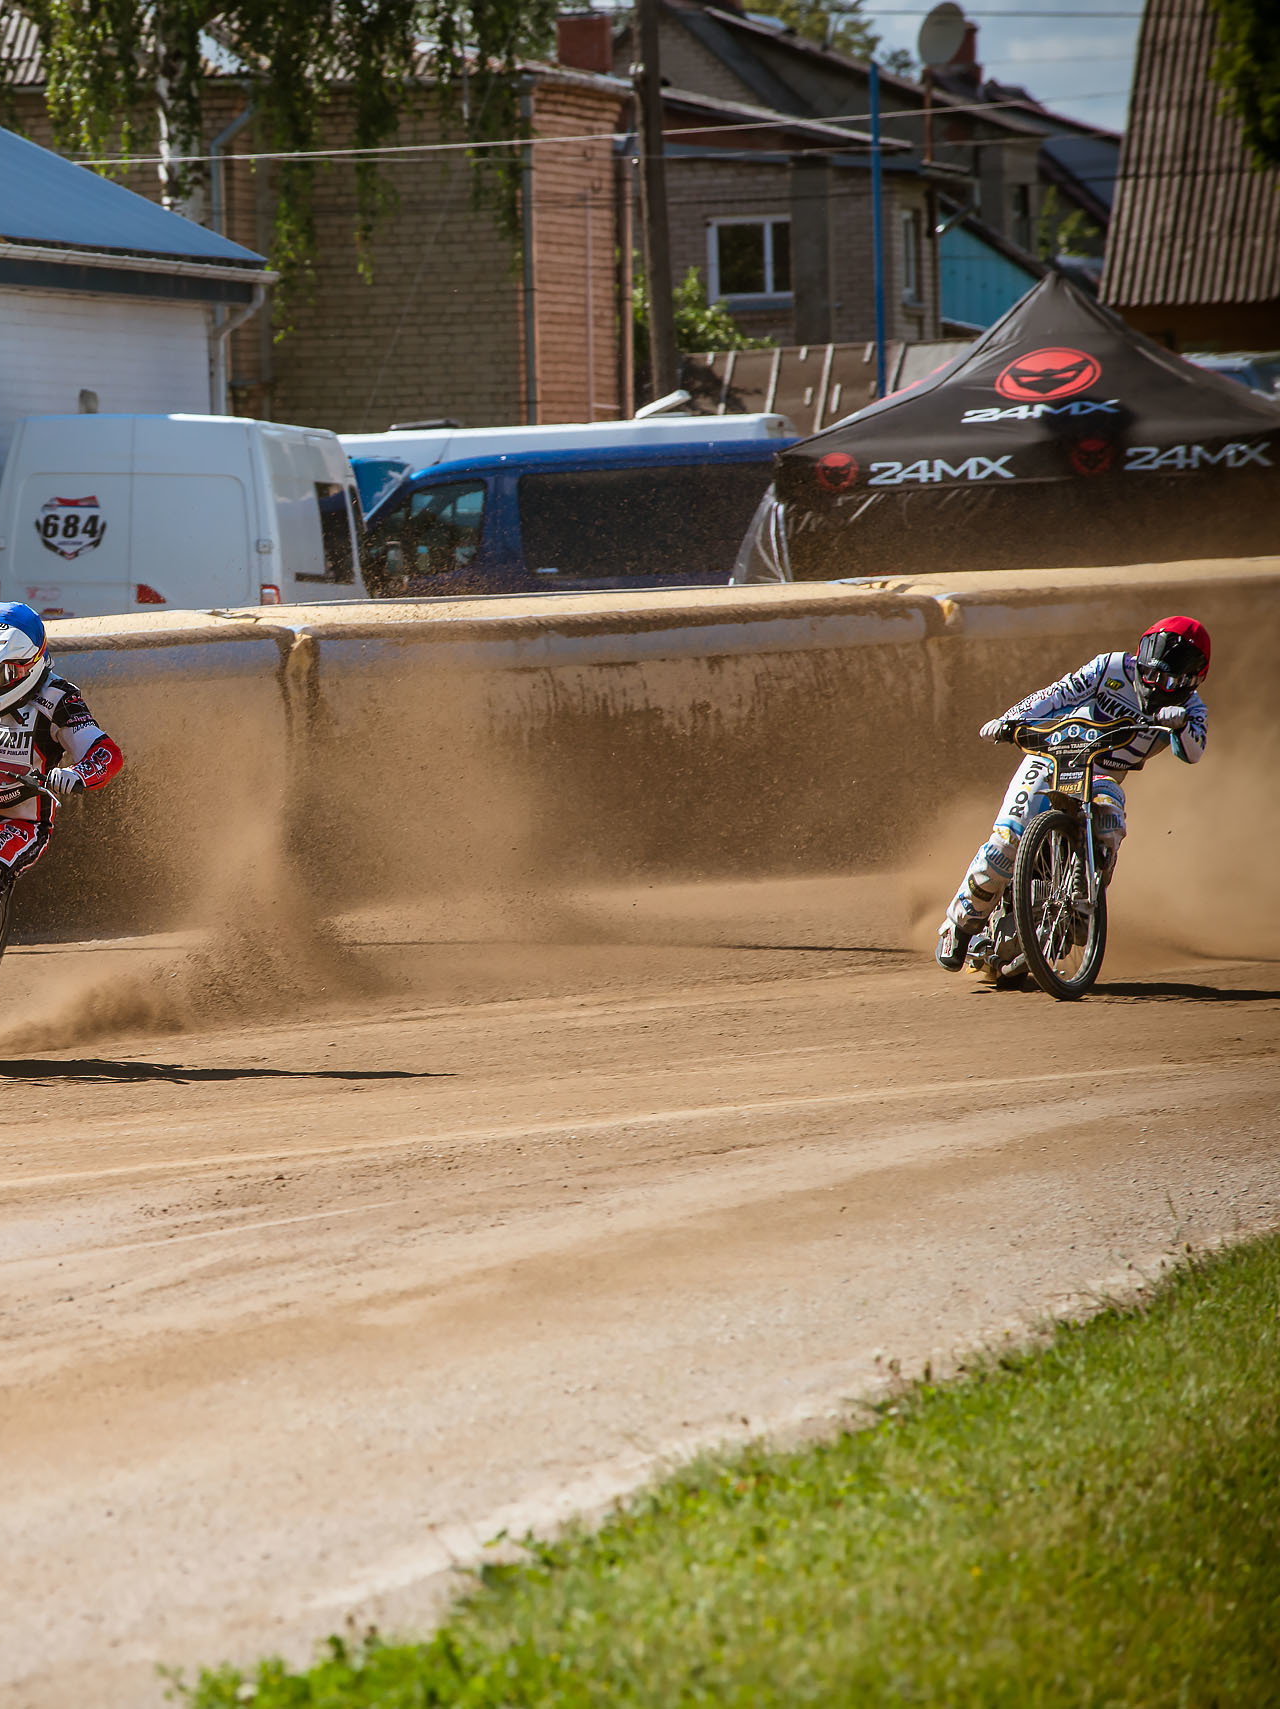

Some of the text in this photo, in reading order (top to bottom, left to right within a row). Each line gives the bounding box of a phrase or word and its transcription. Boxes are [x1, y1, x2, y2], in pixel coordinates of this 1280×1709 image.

[961, 399, 1120, 424] 24MX
[867, 454, 1015, 486] 24MX
[1124, 441, 1274, 471] 24MX
[42, 513, 100, 539] 684
